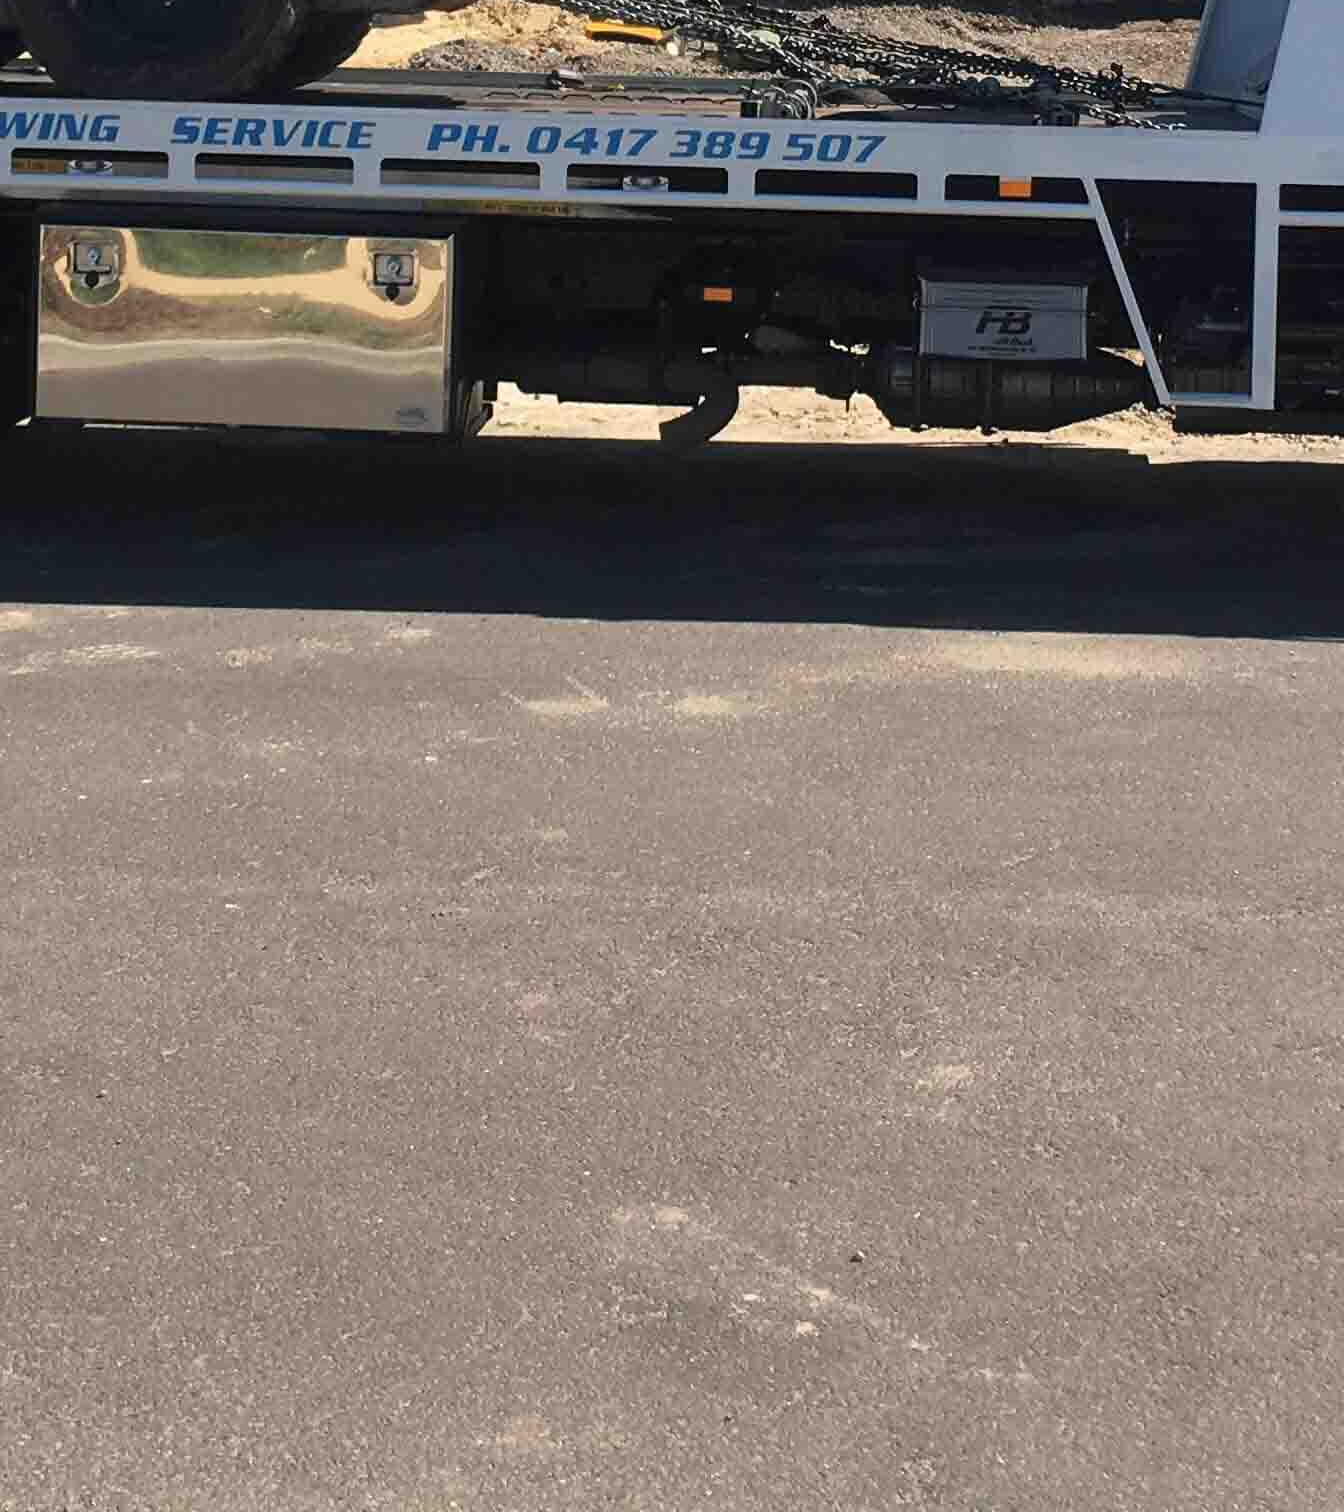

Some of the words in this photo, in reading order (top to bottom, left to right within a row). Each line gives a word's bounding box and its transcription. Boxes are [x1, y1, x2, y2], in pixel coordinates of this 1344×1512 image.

[170, 117, 377, 150] SERVICE
[426, 124, 510, 153] PH.
[526, 127, 657, 157] 0417
[669, 131, 771, 160] 389
[782, 134, 886, 163] 507
